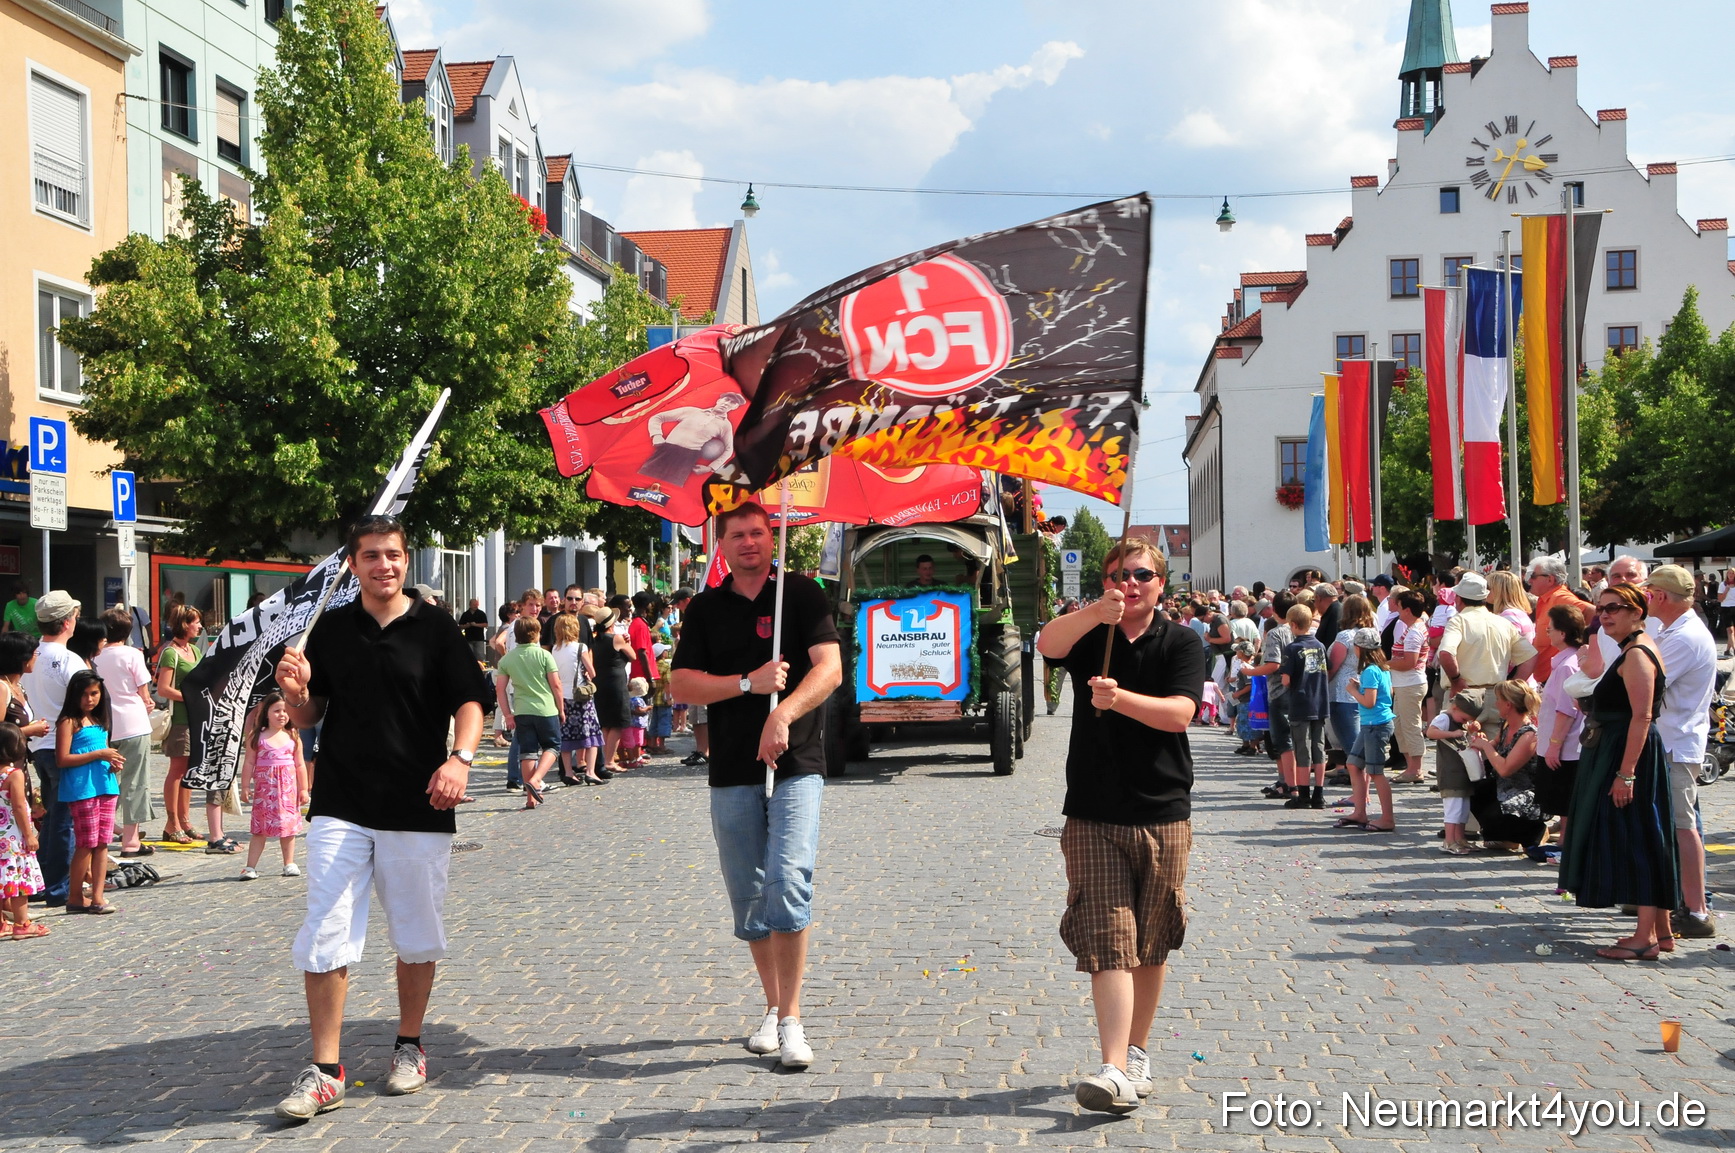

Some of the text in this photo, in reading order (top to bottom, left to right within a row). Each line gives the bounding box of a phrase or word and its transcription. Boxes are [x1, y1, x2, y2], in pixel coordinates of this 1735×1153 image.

[615, 374, 646, 396] Tucher
[38, 424, 59, 465] P
[34, 485, 64, 496] Parkschein
[117, 477, 131, 515] P
[37, 496, 62, 506] werktags
[931, 641, 951, 649] guter
[922, 649, 952, 657] Schluck
